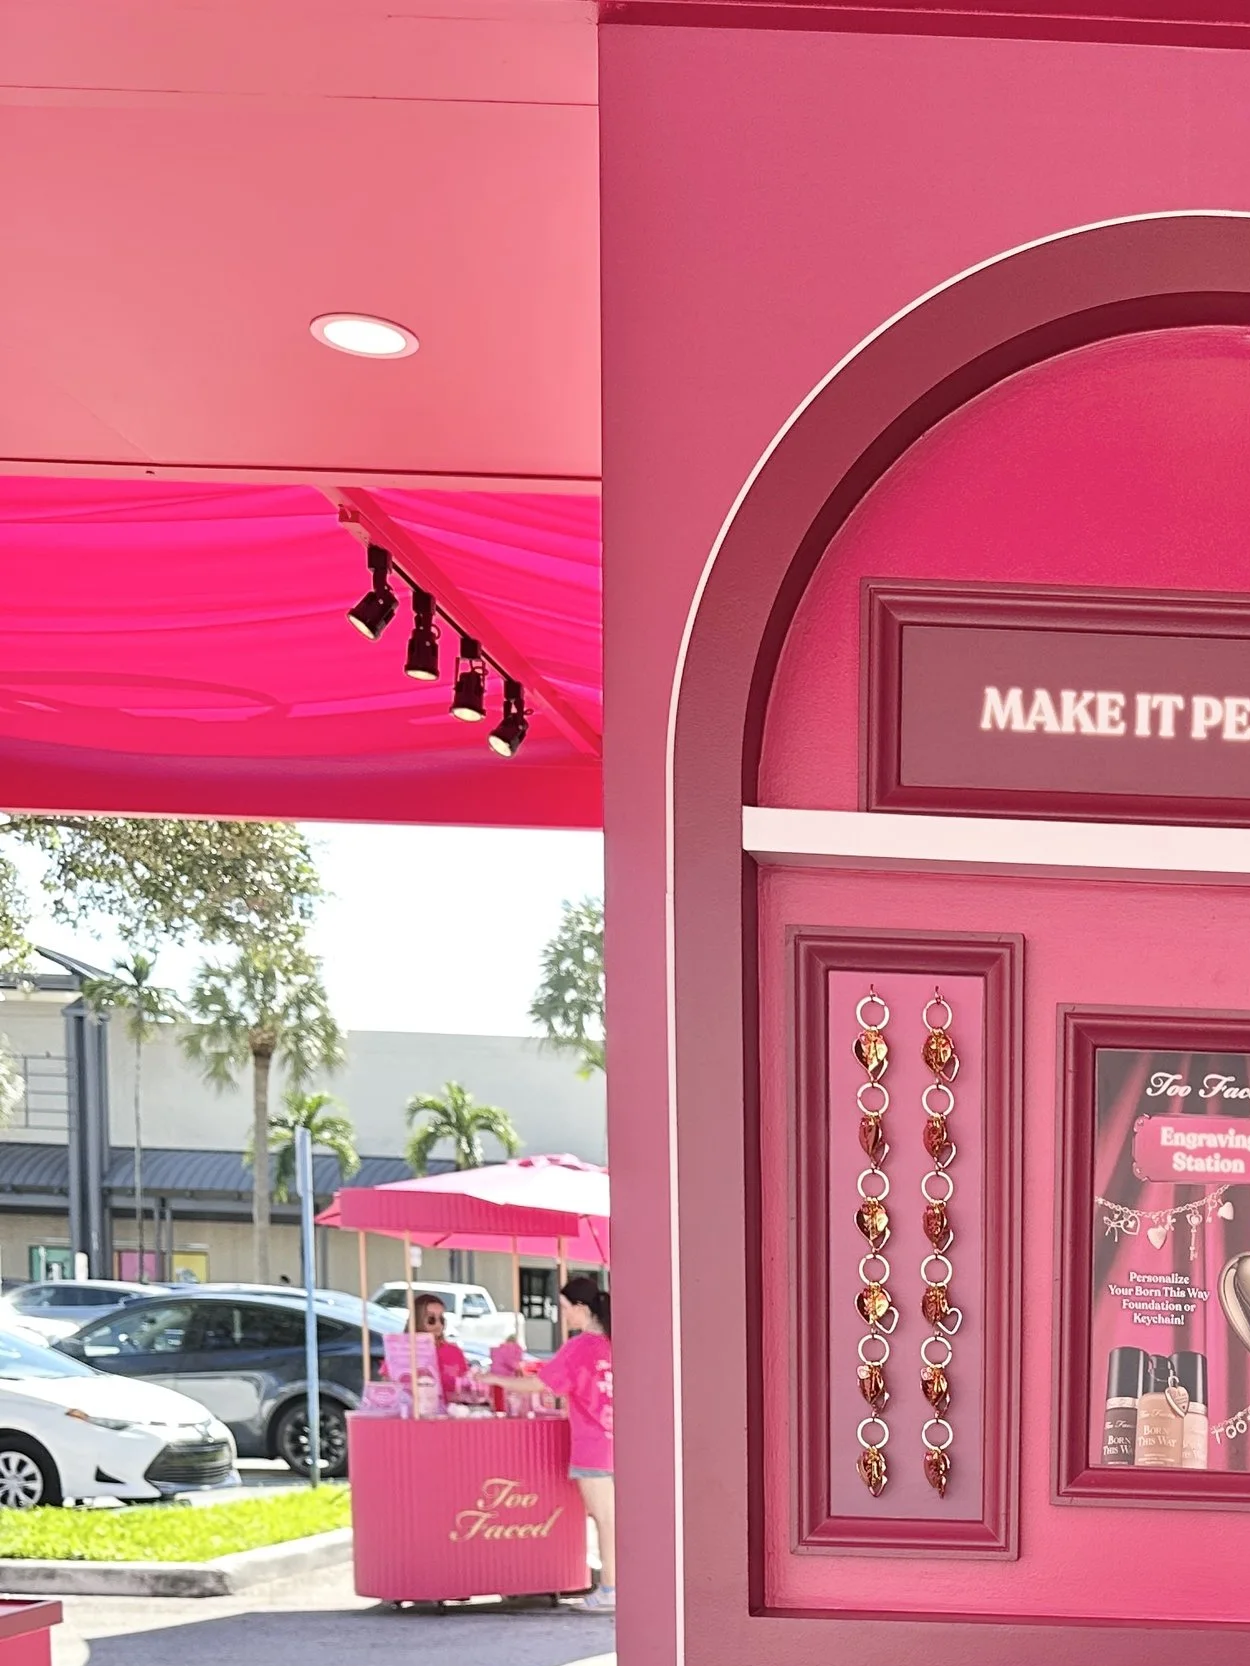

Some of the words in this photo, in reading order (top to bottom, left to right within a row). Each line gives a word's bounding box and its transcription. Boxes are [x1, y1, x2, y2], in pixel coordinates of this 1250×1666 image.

[980, 687, 1126, 736] MAKE
[1134, 692, 1184, 737] IT
[1146, 1072, 1191, 1098] Too
[1172, 1152, 1245, 1174] Station
[1129, 1271, 1190, 1284] Personalize
[1108, 1285, 1134, 1296] Your
[1135, 1285, 1161, 1297] Born
[1162, 1286, 1186, 1298] This
[1187, 1288, 1210, 1301] Way
[1122, 1298, 1182, 1312] Foundation
[1183, 1303, 1197, 1312] or
[1133, 1312, 1185, 1326] Keychain!
[1210, 1419, 1247, 1444] TOO
[477, 1478, 539, 1510] Too
[450, 1506, 563, 1543] Faced
